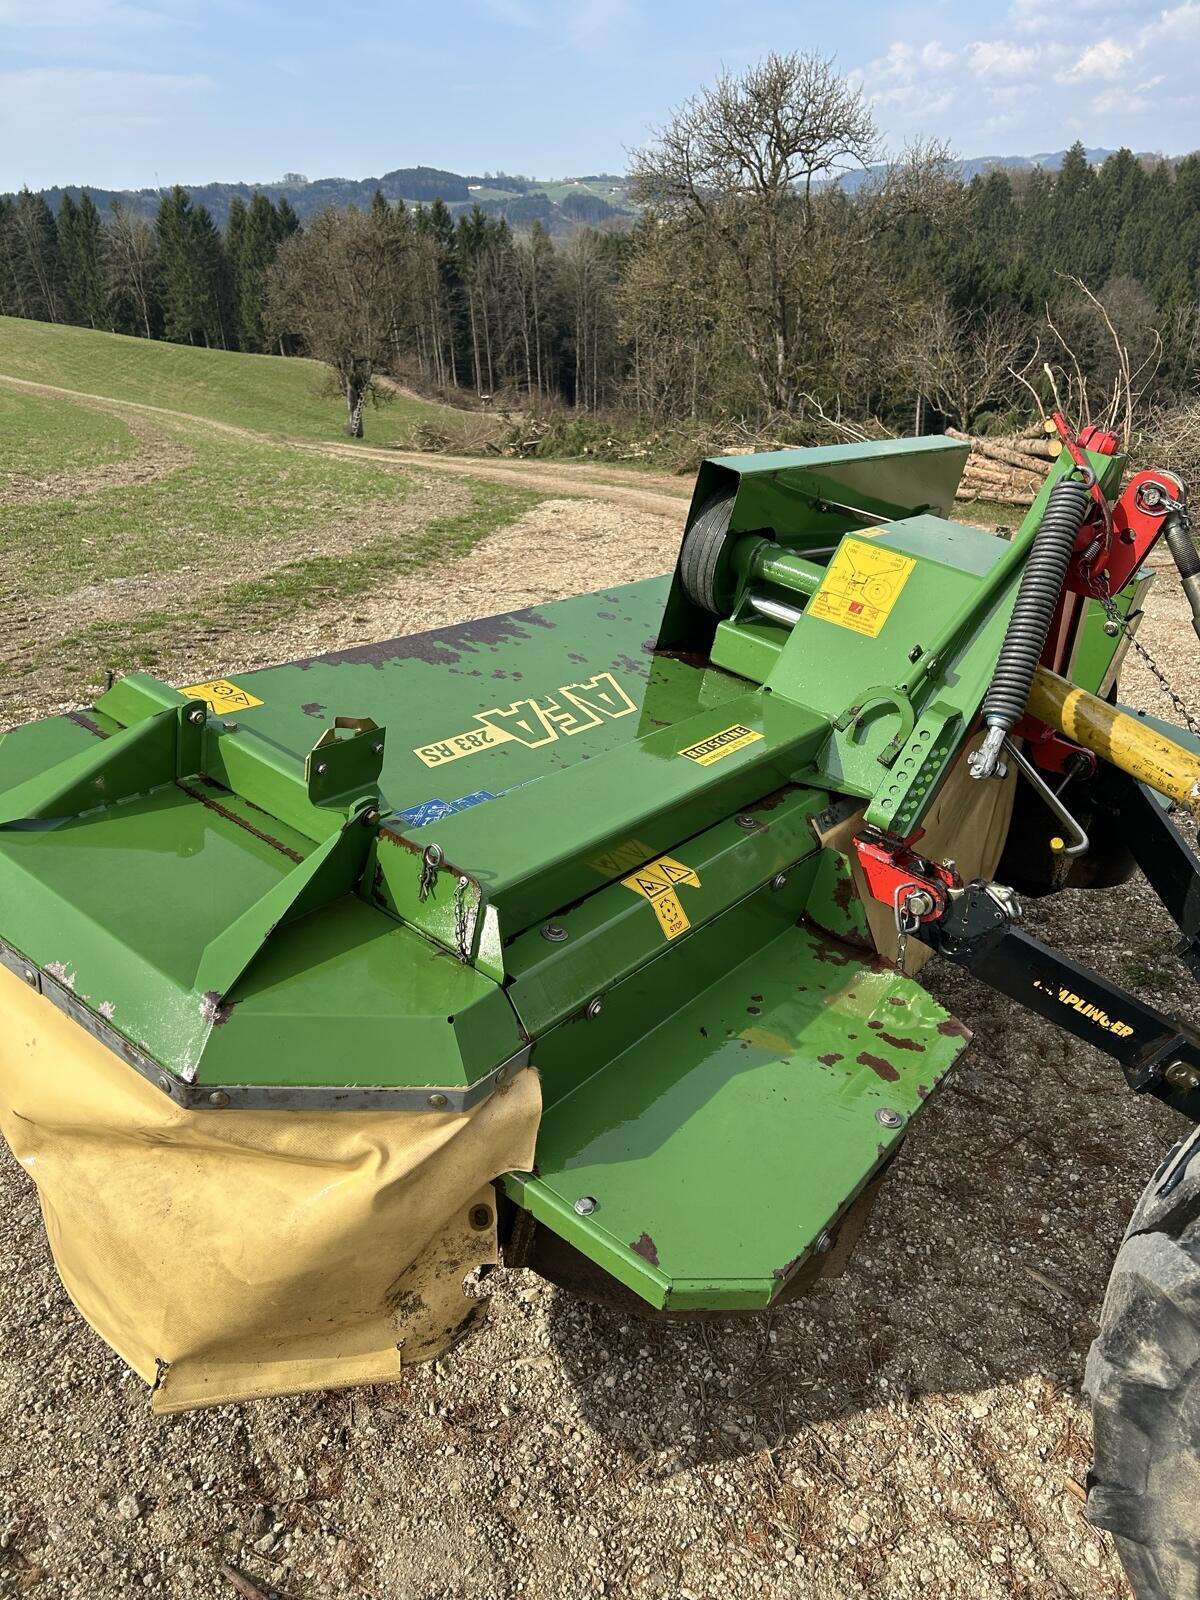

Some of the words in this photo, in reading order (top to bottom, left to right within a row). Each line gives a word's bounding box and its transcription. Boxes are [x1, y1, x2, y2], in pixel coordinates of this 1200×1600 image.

[453, 729, 495, 751] 283
[420, 743, 451, 763] RS
[669, 920, 684, 933] STOP
